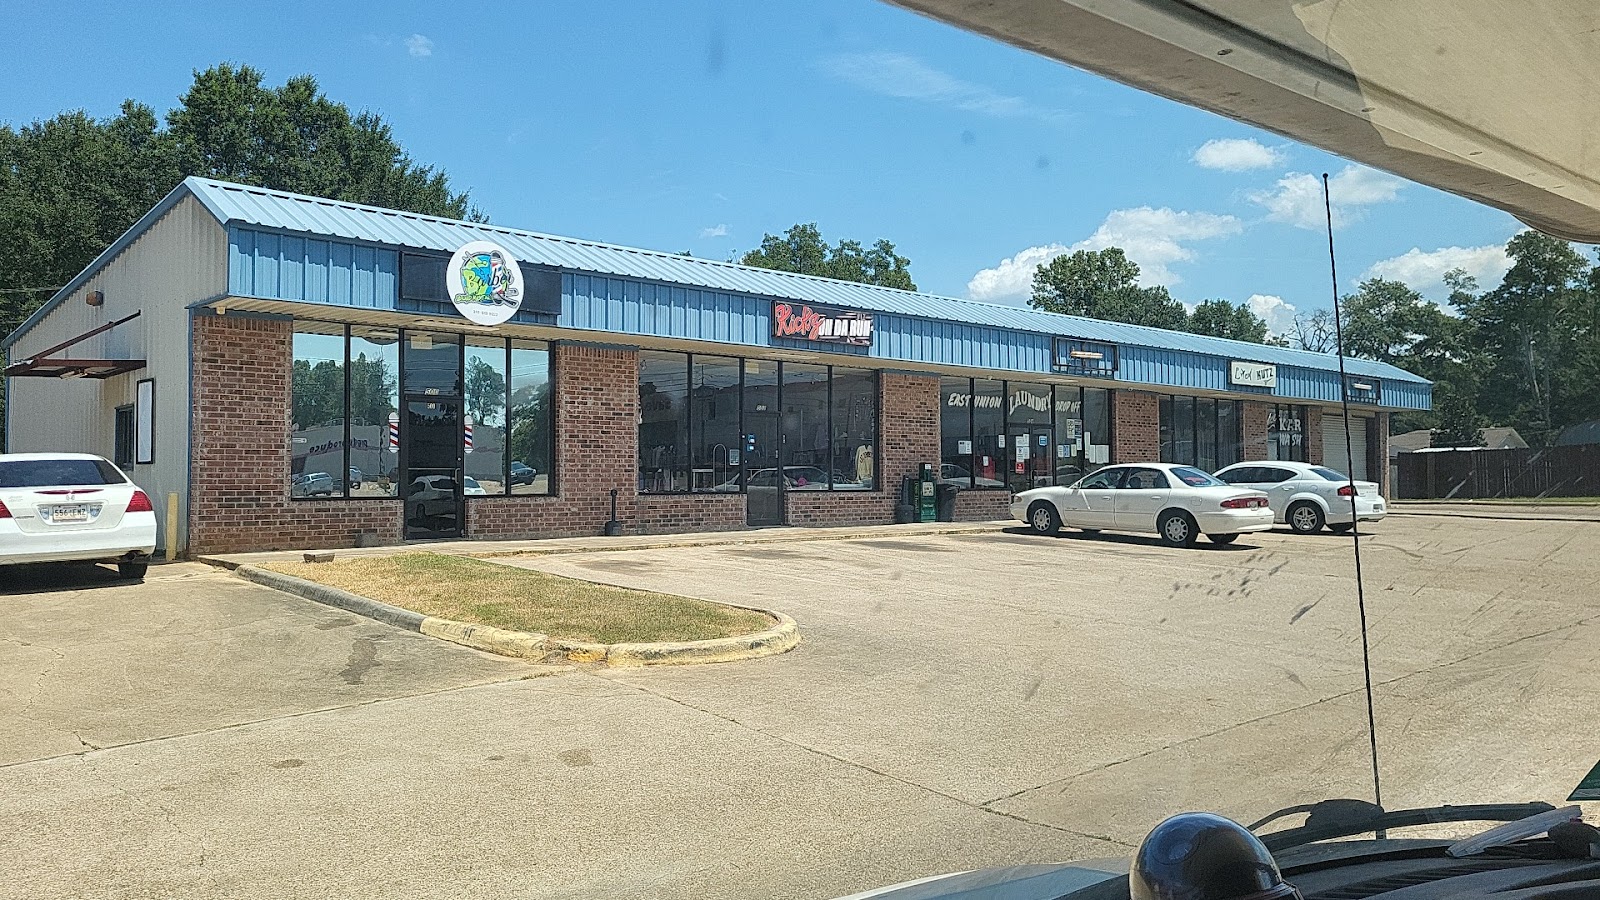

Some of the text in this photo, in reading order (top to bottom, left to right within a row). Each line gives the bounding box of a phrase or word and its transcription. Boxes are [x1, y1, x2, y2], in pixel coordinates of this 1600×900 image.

[834, 318, 848, 336] DA
[849, 319, 871, 337] RUN
[948, 390, 1082, 416] EAST UNION LAUNDRY DROP OFF
[1278, 418, 1302, 432] KAR
[1279, 433, 1303, 446] WASH
